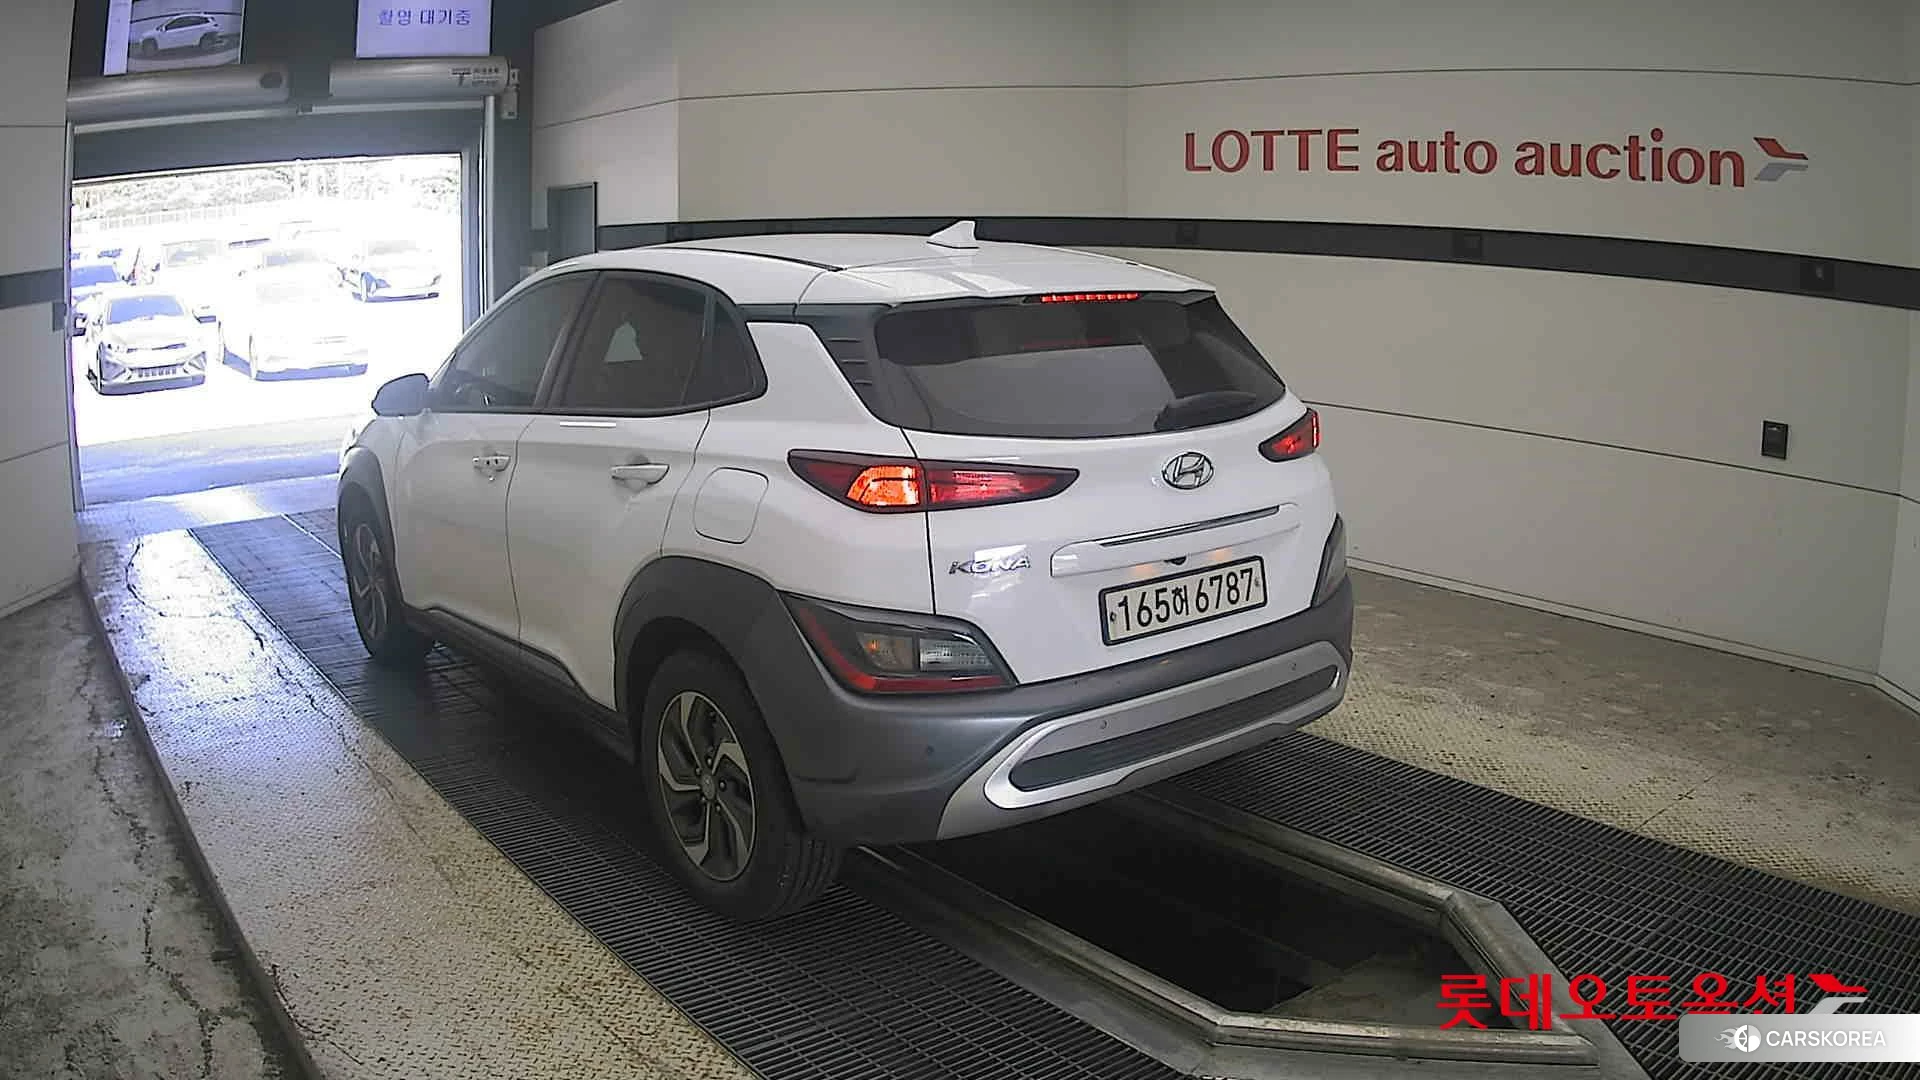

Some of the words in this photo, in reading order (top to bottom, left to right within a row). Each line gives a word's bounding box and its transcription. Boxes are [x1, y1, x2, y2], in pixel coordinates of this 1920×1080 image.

[420, 8, 471, 26] 대기중
[1184, 128, 1360, 173] LOTTE
[1376, 131, 1498, 174] auto
[1515, 128, 1745, 187] auction
[948, 556, 1031, 575] KONA
